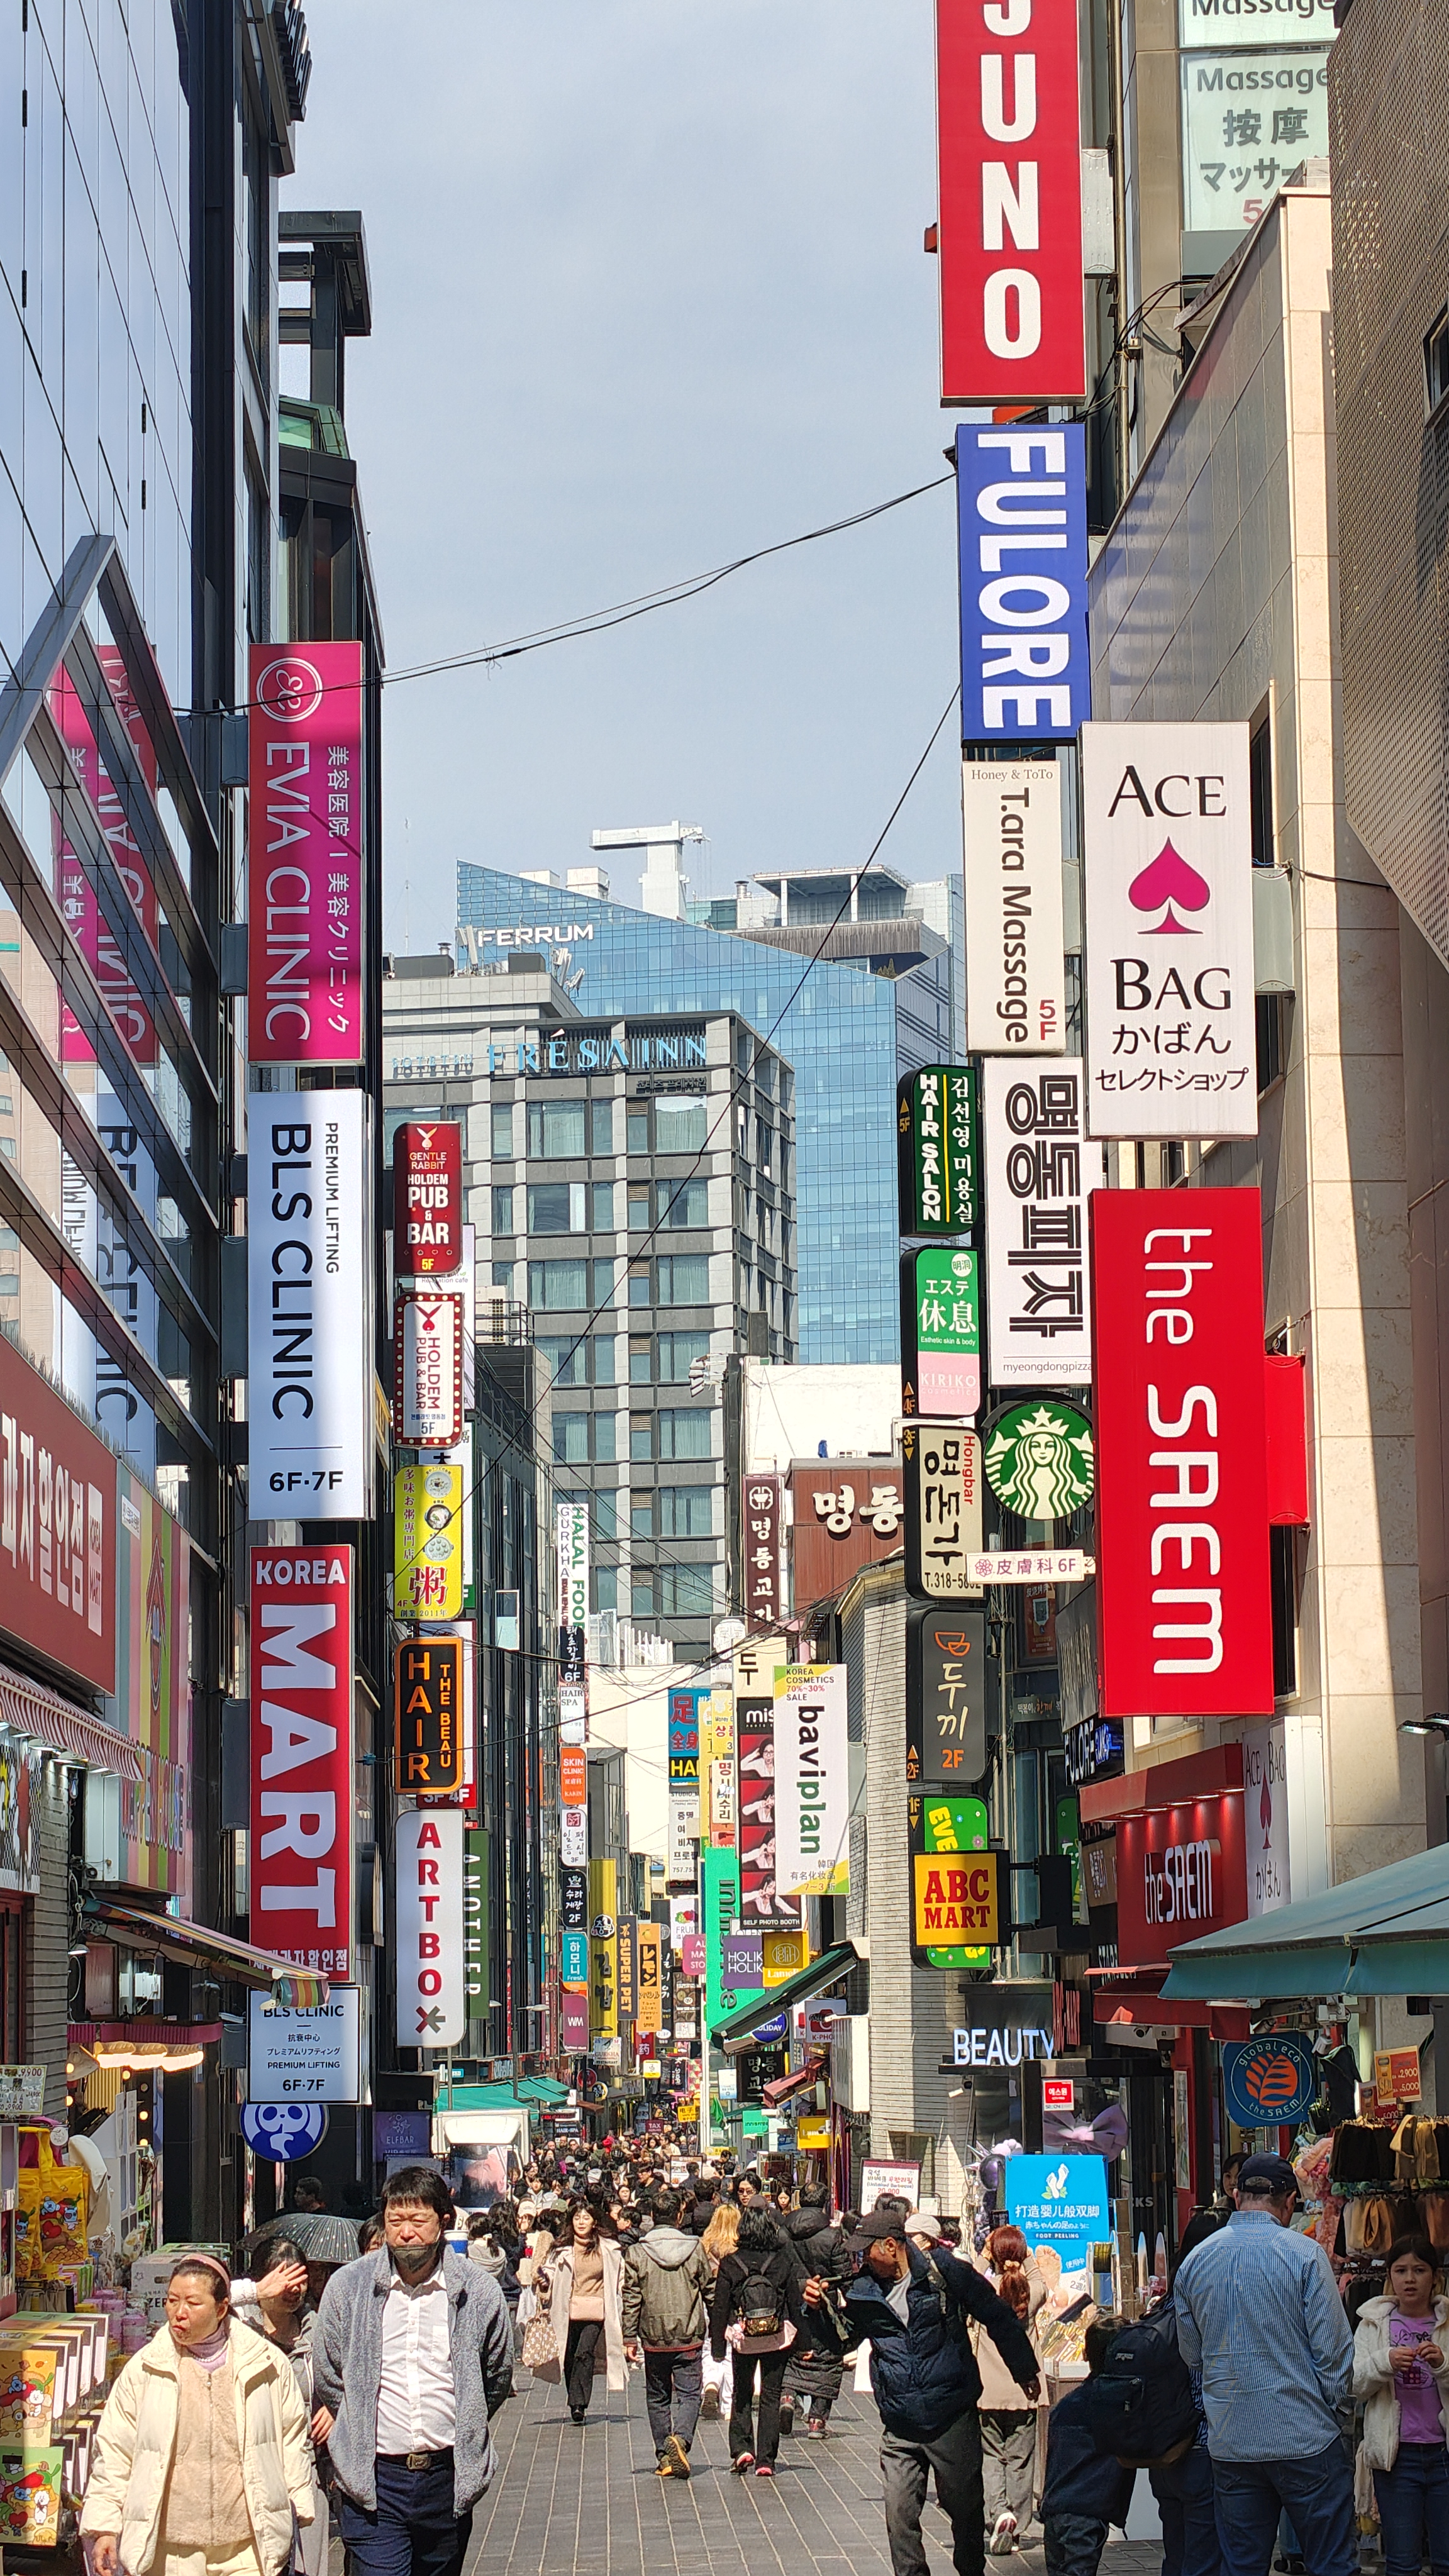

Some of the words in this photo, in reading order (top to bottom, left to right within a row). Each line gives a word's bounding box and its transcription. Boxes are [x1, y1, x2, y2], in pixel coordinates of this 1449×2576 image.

[1222, 107, 1309, 147] 按摩
[977, 432, 1071, 729] FULORE
[326, 746, 350, 838] 美容医院
[972, 769, 1008, 782] Honey
[1011, 769, 1021, 780] &
[1023, 769, 1054, 780] ToTo
[1108, 765, 1227, 818] ACE
[266, 742, 310, 853] EVIA
[1000, 786, 1030, 872] T.ara
[477, 923, 594, 947] FERRUM
[265, 866, 311, 1041] CLINIC
[326, 872, 350, 1035] 美容クリニック
[996, 885, 1032, 1043] Massage
[1110, 958, 1232, 1011] BAG
[1111, 1023, 1232, 1055] かばん
[1095, 1067, 1250, 1092] セレクトショップ
[919, 1074, 939, 1138] HAIR
[950, 1075, 971, 1148] 김선영
[270, 1123, 313, 1221] BLS
[325, 1122, 340, 1201] PREMIUM
[409, 1152, 447, 1161] GENTLE
[411, 1161, 445, 1170] RABBIT
[407, 1174, 448, 1185] HOLDEM
[408, 1187, 448, 1208] PUB
[921, 1143, 941, 1221] SALON
[952, 1153, 975, 1224] 미용실
[425, 1210, 433, 1221] &
[1005, 1074, 1084, 1338] 명동피자
[326, 1206, 340, 1274] LIFTING
[407, 1223, 450, 1245] BAR
[421, 1258, 435, 1270] 5F
[925, 1279, 969, 1296] エステ
[1144, 1228, 1213, 1345] the
[271, 1239, 314, 1420] CLINIC
[919, 1298, 976, 1333] 休息
[416, 1337, 426, 1364] PUB
[416, 1368, 426, 1378] &
[428, 1337, 440, 1410] HOLDEM
[921, 1373, 976, 1387] KIRIKO
[416, 1383, 426, 1410] BAR
[421, 1421, 436, 1435] 5F
[962, 1435, 976, 1505] Hongbar
[560, 1506, 570, 1578] GURKHA
[572, 1506, 586, 1570] HALAL
[256, 1559, 346, 1585] KOREA
[997, 1558, 1054, 1575] 皮膚科
[1058, 1558, 1077, 1573] 6F
[409, 1565, 447, 1606] 粥
[440, 1664, 451, 1706] THE
[565, 1672, 581, 1682] 6F
[406, 1652, 432, 1781] HAIR
[670, 1695, 696, 1724] 足
[936, 1662, 969, 1741] 두끼
[440, 1712, 452, 1768] BEAU
[670, 1729, 699, 1751] 全身
[941, 1748, 965, 1768] 2F
[260, 1603, 337, 1928] MART
[563, 1758, 584, 1767] SKIN
[796, 1705, 827, 1854] baviplan
[923, 1868, 990, 1904] ABC
[464, 1853, 481, 1997] ANOTHER
[568, 1914, 582, 1923] 2F
[924, 1905, 991, 1929] MART
[619, 1938, 632, 1984] SUPER
[294, 2004, 345, 2017] CLINIC
[621, 1987, 632, 2012] PET
[266, 2046, 341, 2056] プレミアムリフティング
[287, 2033, 321, 2043] 抗衰中心
[953, 2028, 1055, 2066] BEAUTY
[1238, 2041, 1277, 2067] global
[1281, 2045, 1301, 2063] eco
[267, 2061, 306, 2069] PREMIUM
[308, 2060, 340, 2069] LIFTING
[386, 2135, 414, 2145] ELFBAR
